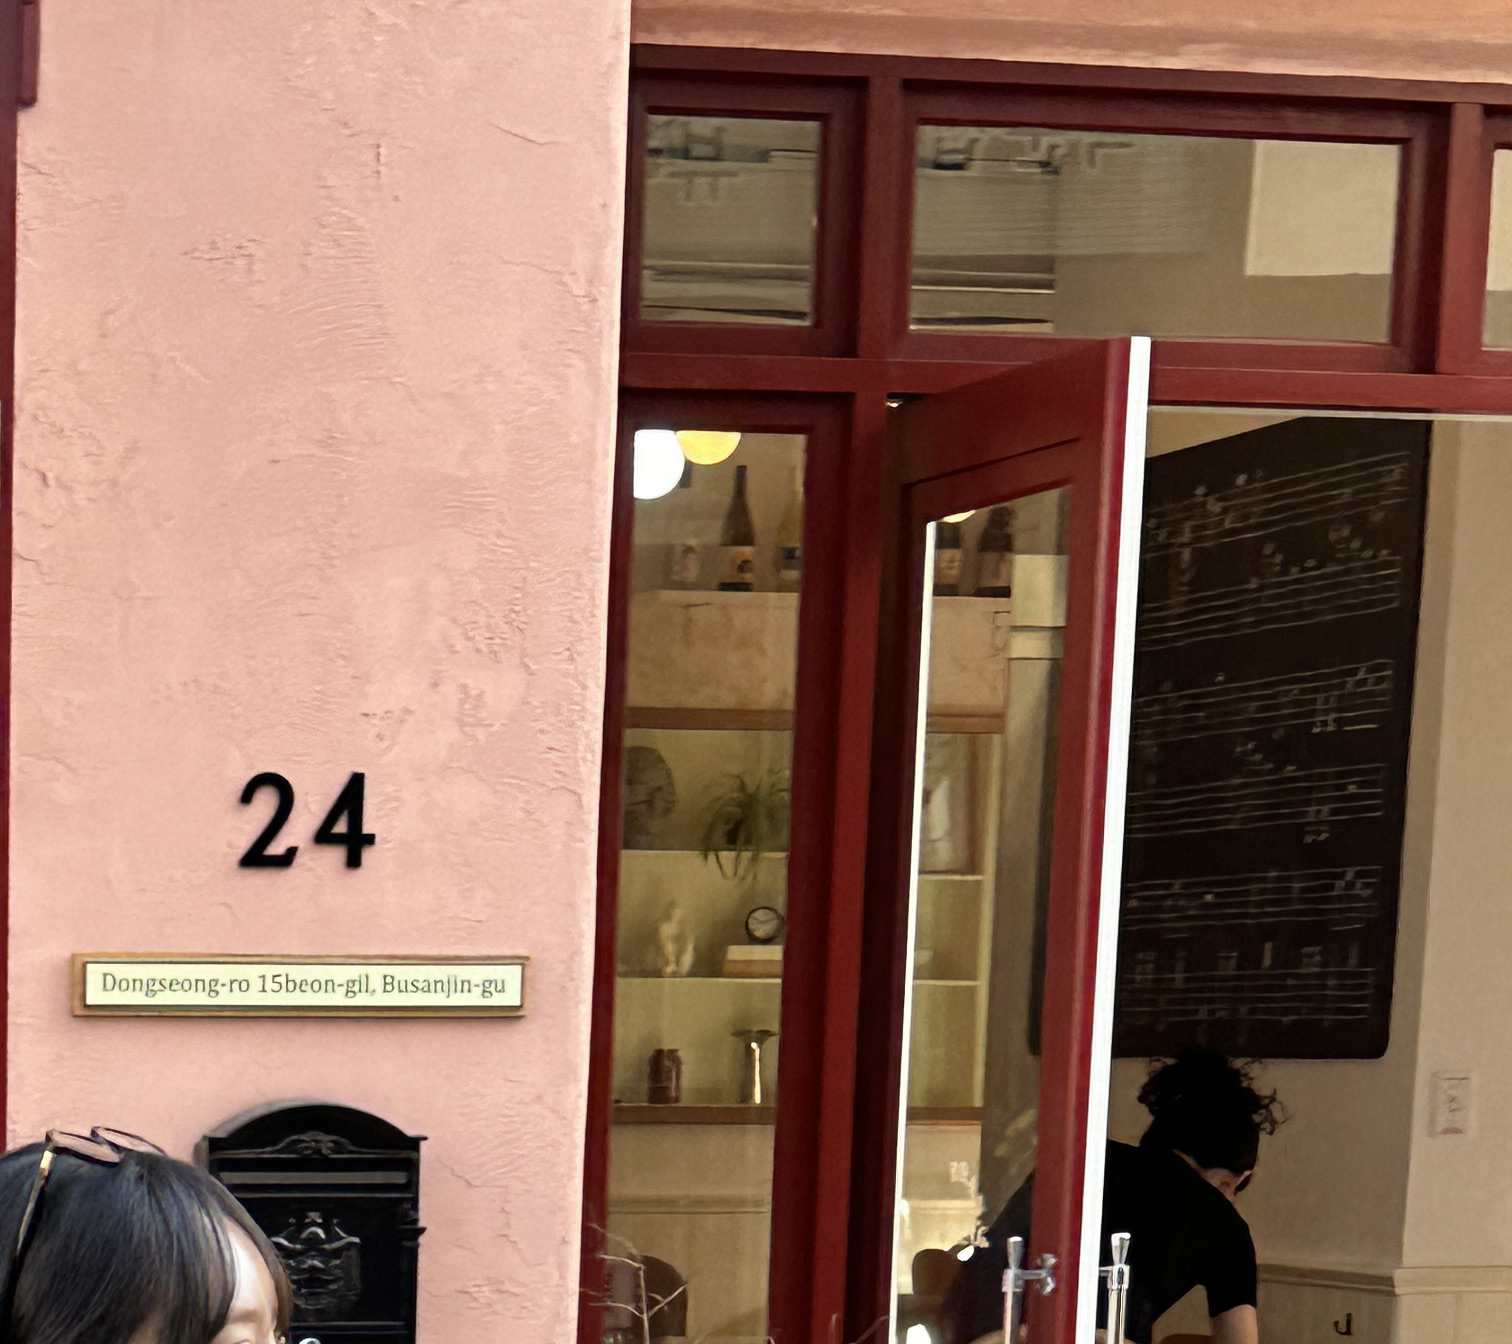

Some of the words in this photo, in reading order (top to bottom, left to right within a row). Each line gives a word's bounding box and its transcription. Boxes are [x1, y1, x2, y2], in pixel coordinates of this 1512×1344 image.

[238, 772, 376, 870] 24
[101, 971, 250, 999] Dongseong-ro
[382, 973, 507, 999] Busanjin-gu
